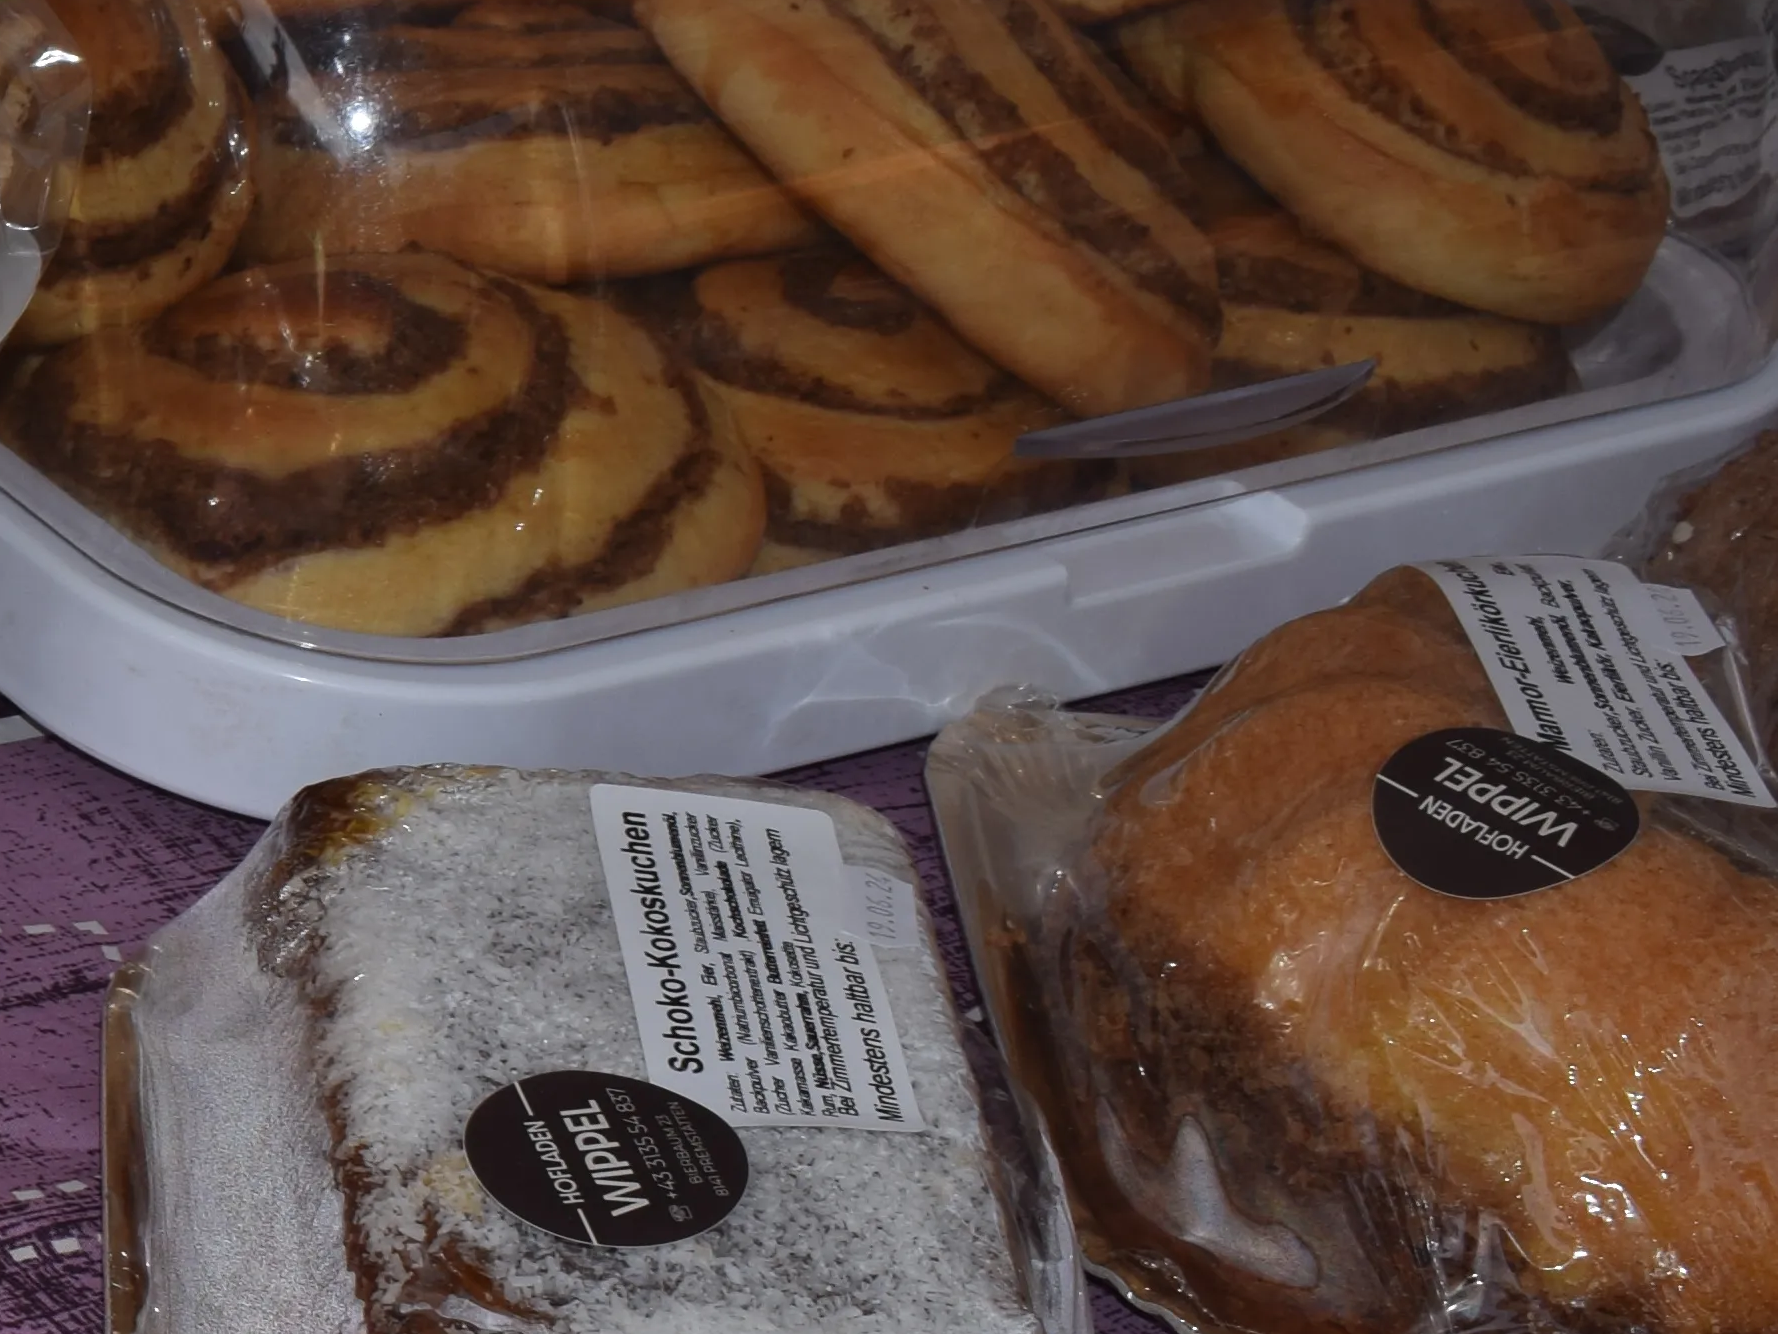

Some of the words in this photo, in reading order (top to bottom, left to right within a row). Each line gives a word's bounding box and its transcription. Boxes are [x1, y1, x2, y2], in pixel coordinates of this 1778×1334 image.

[1669, 684, 1708, 724] haltbar
[1446, 739, 1486, 759] 837
[1697, 728, 1754, 797] Mindestens
[1433, 755, 1579, 848] WIPPEL
[1419, 794, 1530, 860] HOFLADEN
[865, 872, 896, 940] 19.06.24
[623, 813, 703, 1072] Schoko-Kokoskuchen
[795, 945, 820, 969] und
[832, 939, 859, 965] bis:
[701, 963, 718, 986] Eier,
[843, 967, 876, 1023] haltbar
[800, 971, 851, 1092] Zimmertemperatur
[861, 1028, 903, 1122] Mindestens
[606, 1088, 635, 1112] 837
[655, 1115, 673, 1126] 23
[834, 1095, 859, 1116] Bei
[623, 1116, 648, 1134] 54
[525, 1121, 583, 1204] HOFLADEN
[562, 1101, 648, 1215] WIPPEL
[634, 1136, 666, 1168] 3135
[664, 1128, 703, 1184] BIERBAUM
[652, 1172, 677, 1198] +43
